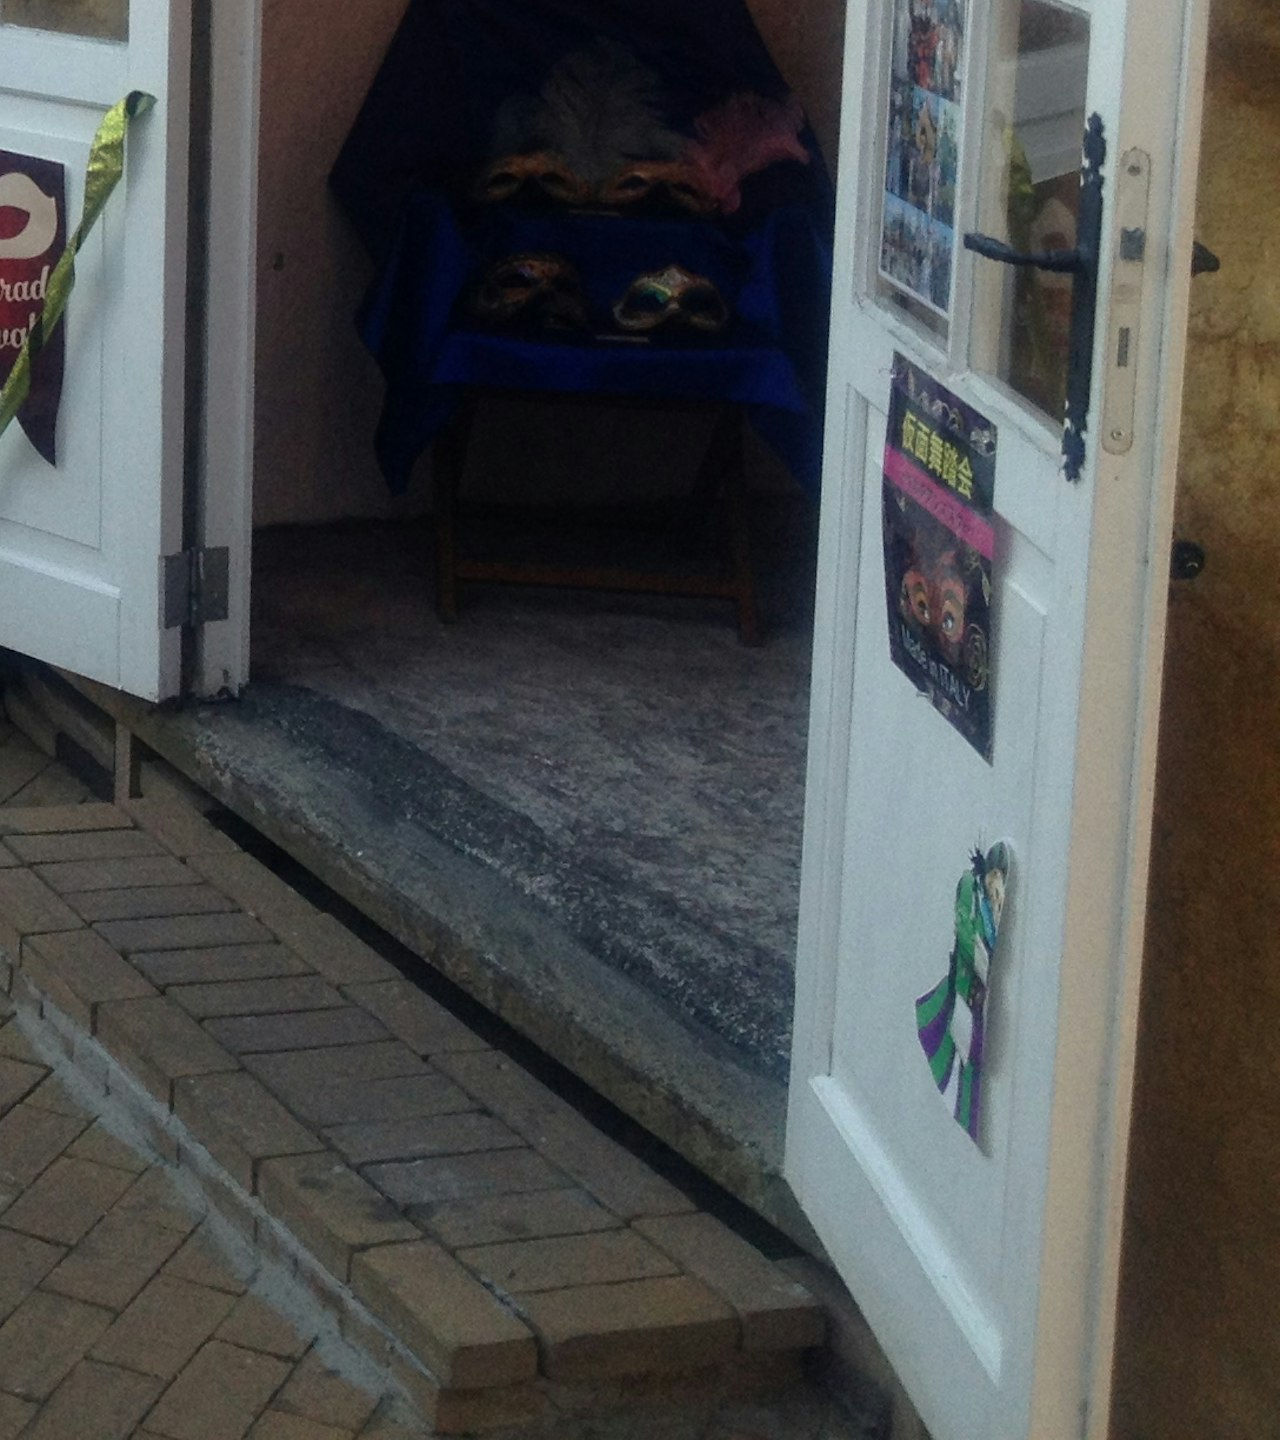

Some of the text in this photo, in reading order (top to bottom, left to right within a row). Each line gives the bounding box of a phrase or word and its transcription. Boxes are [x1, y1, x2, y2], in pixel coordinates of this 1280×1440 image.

[902, 410, 973, 501] 仮面舞踏会
